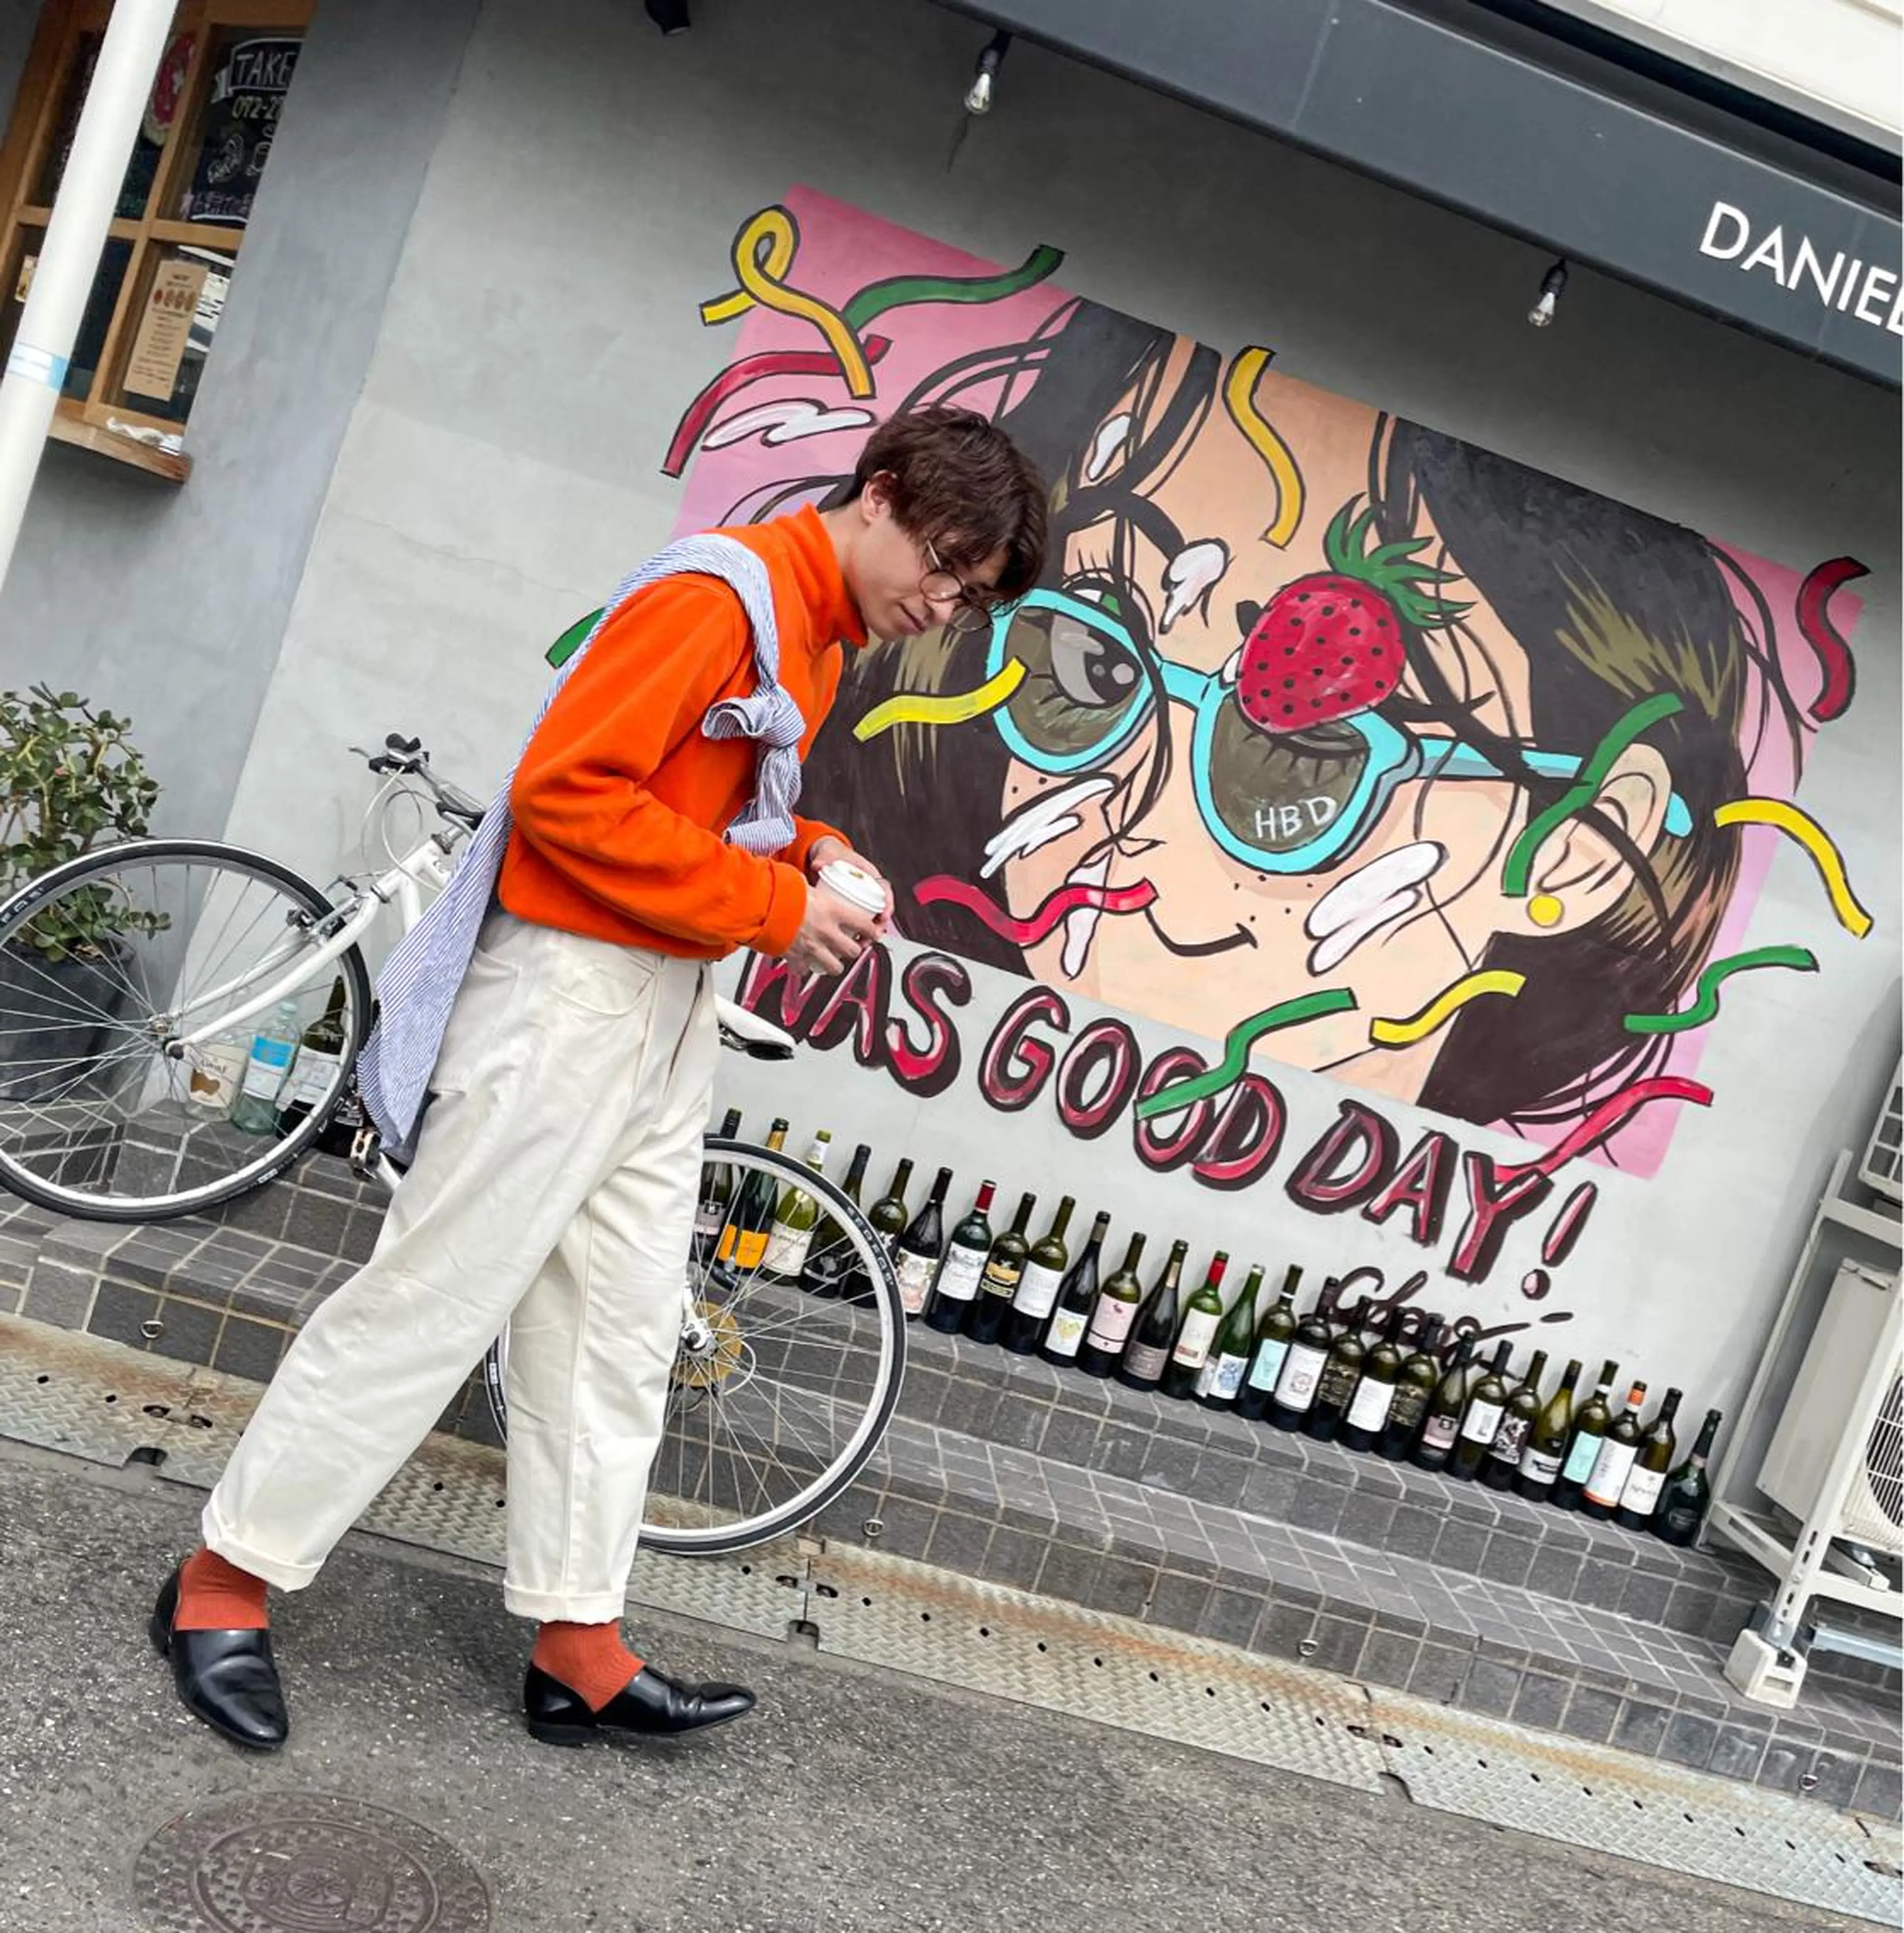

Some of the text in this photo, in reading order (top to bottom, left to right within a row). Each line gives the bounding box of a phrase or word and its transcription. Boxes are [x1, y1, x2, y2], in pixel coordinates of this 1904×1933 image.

[236, 50, 298, 85] TAKE
[1255, 796, 1338, 840] HBD
[978, 985, 1287, 1191] GOOD
